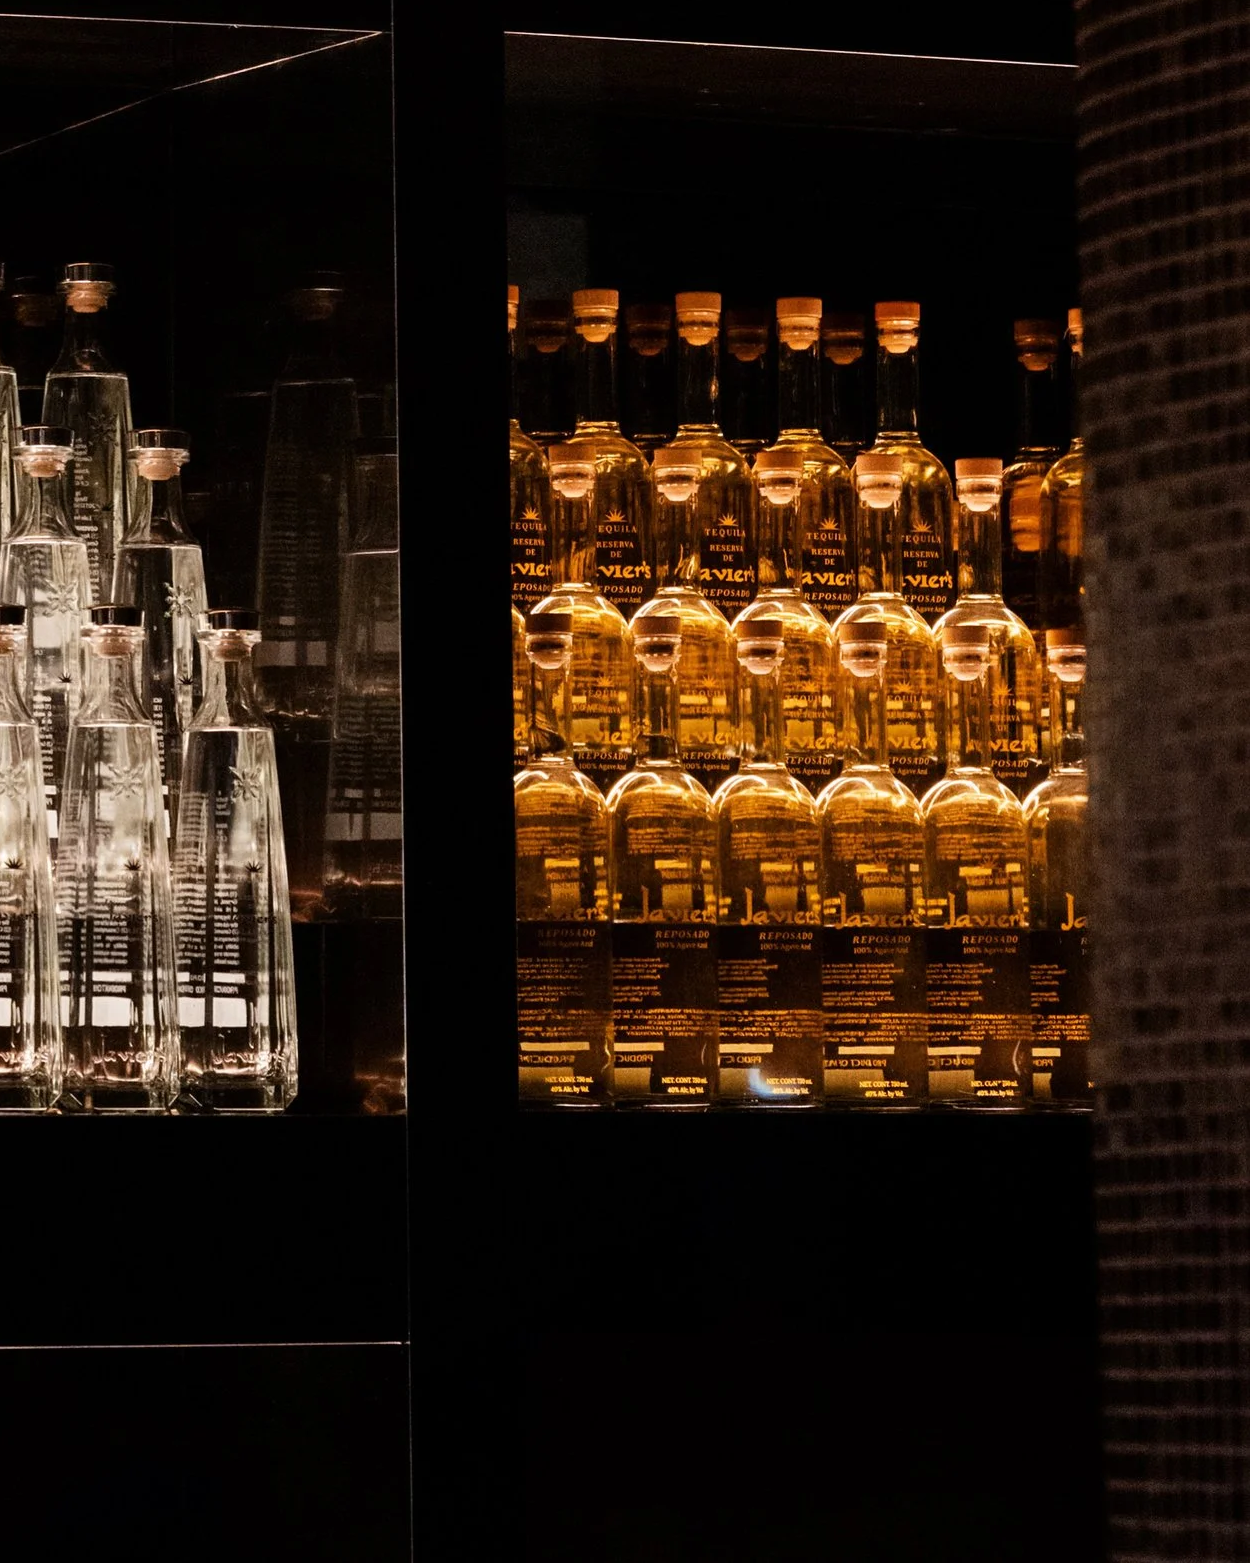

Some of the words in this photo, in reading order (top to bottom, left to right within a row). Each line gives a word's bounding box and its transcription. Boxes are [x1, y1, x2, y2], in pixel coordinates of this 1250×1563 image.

[704, 528, 746, 537] TEQUILA
[806, 533, 847, 541] TEQUILA
[513, 538, 545, 547] RESERVA
[596, 541, 634, 549] RESERVA
[525, 548, 536, 556] DE
[710, 544, 743, 552] RESERVA
[811, 548, 845, 556] RESERVA
[723, 554, 733, 562] DE
[903, 551, 939, 559] RESERVA
[702, 589, 750, 598] REPOSADO
[805, 593, 851, 601] REPOSADO
[682, 752, 730, 760] REPOSADO
[656, 930, 710, 938] REPOSADO
[759, 932, 813, 940] REPOSADO
[852, 935, 911, 944] REPOSADO
[962, 935, 1018, 944] REPOSADO
[677, 942, 696, 950] Agave
[780, 943, 799, 951] Agave
[874, 947, 894, 955] Agave
